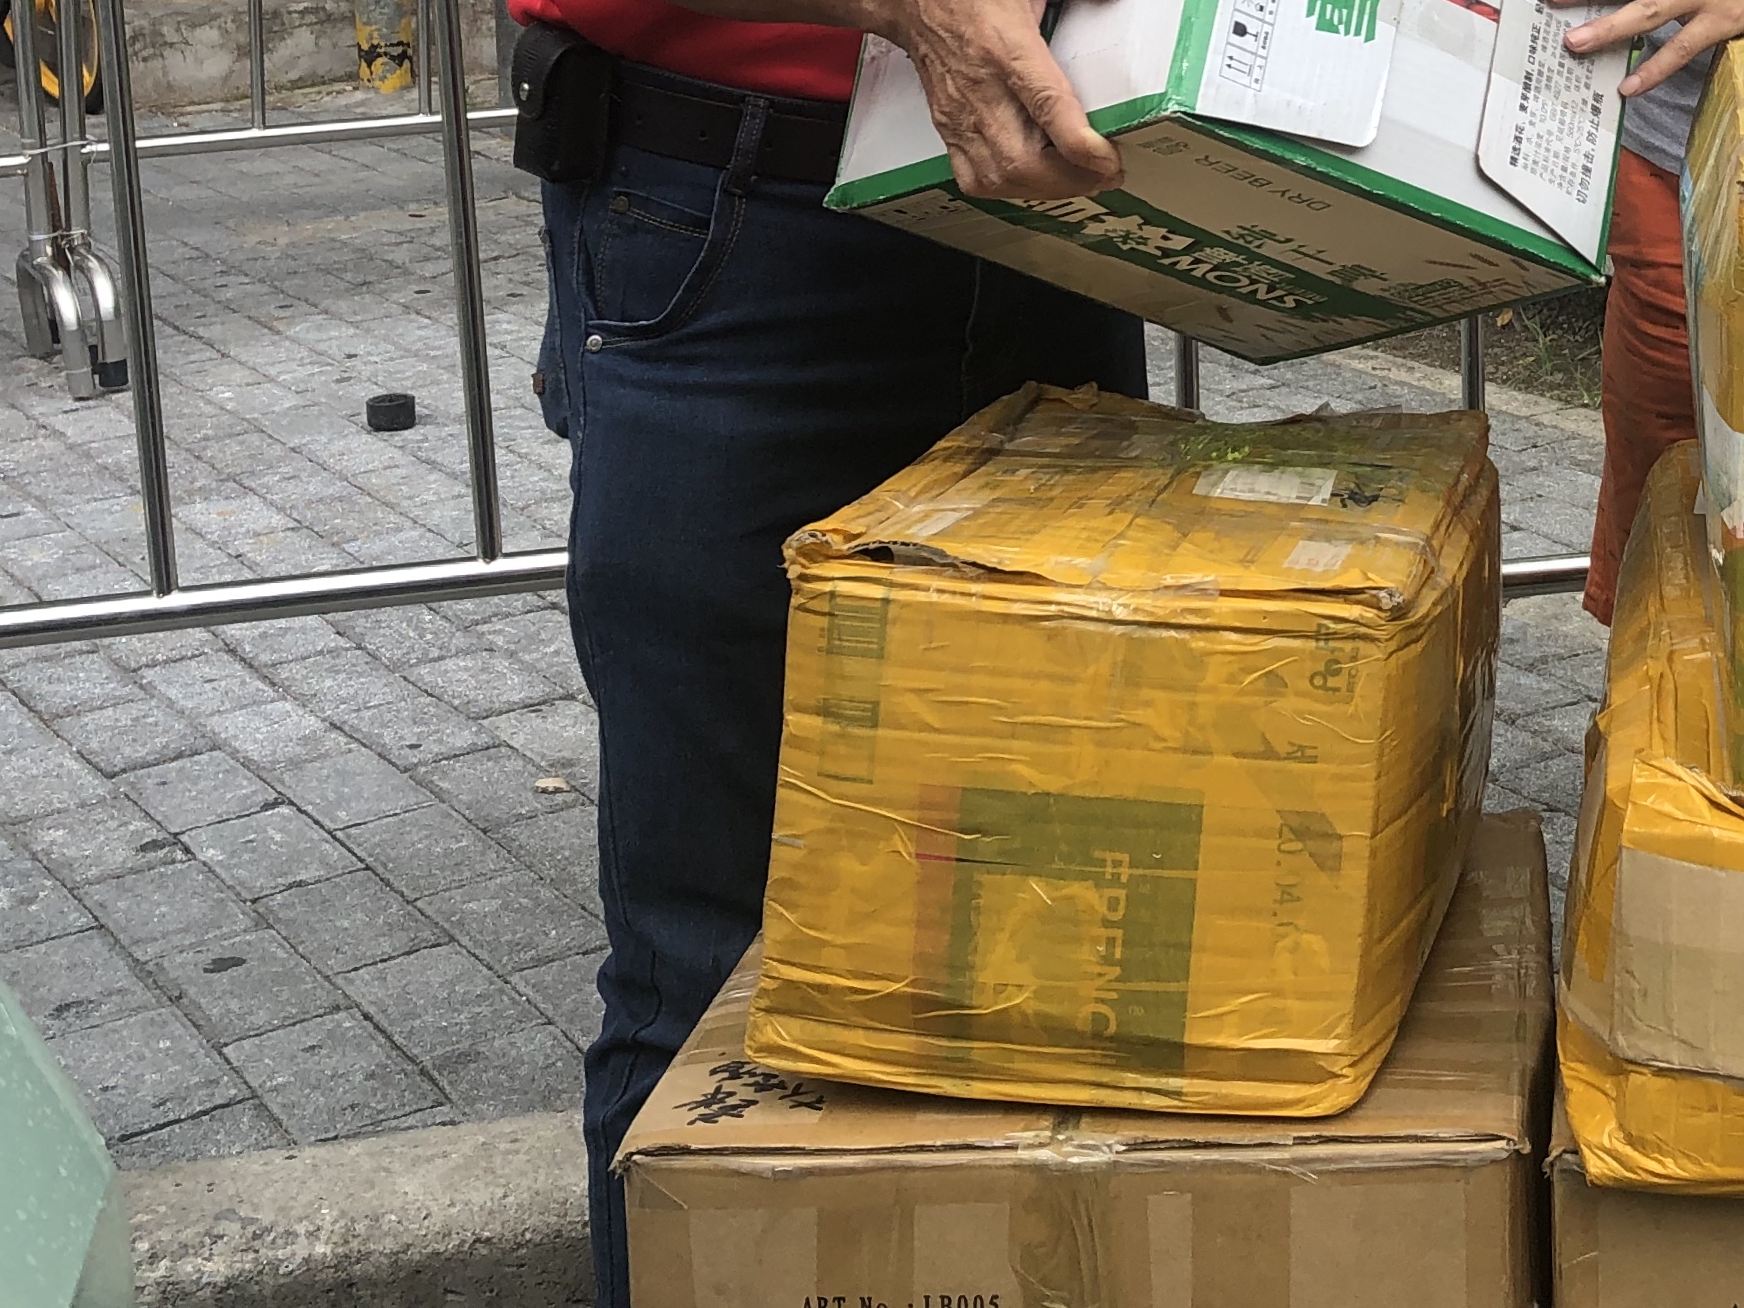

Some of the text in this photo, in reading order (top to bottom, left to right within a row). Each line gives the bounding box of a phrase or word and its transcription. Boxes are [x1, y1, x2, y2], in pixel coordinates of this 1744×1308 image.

[1195, 155, 1333, 212] DRY BEER
[1157, 255, 1316, 309] SNOW
